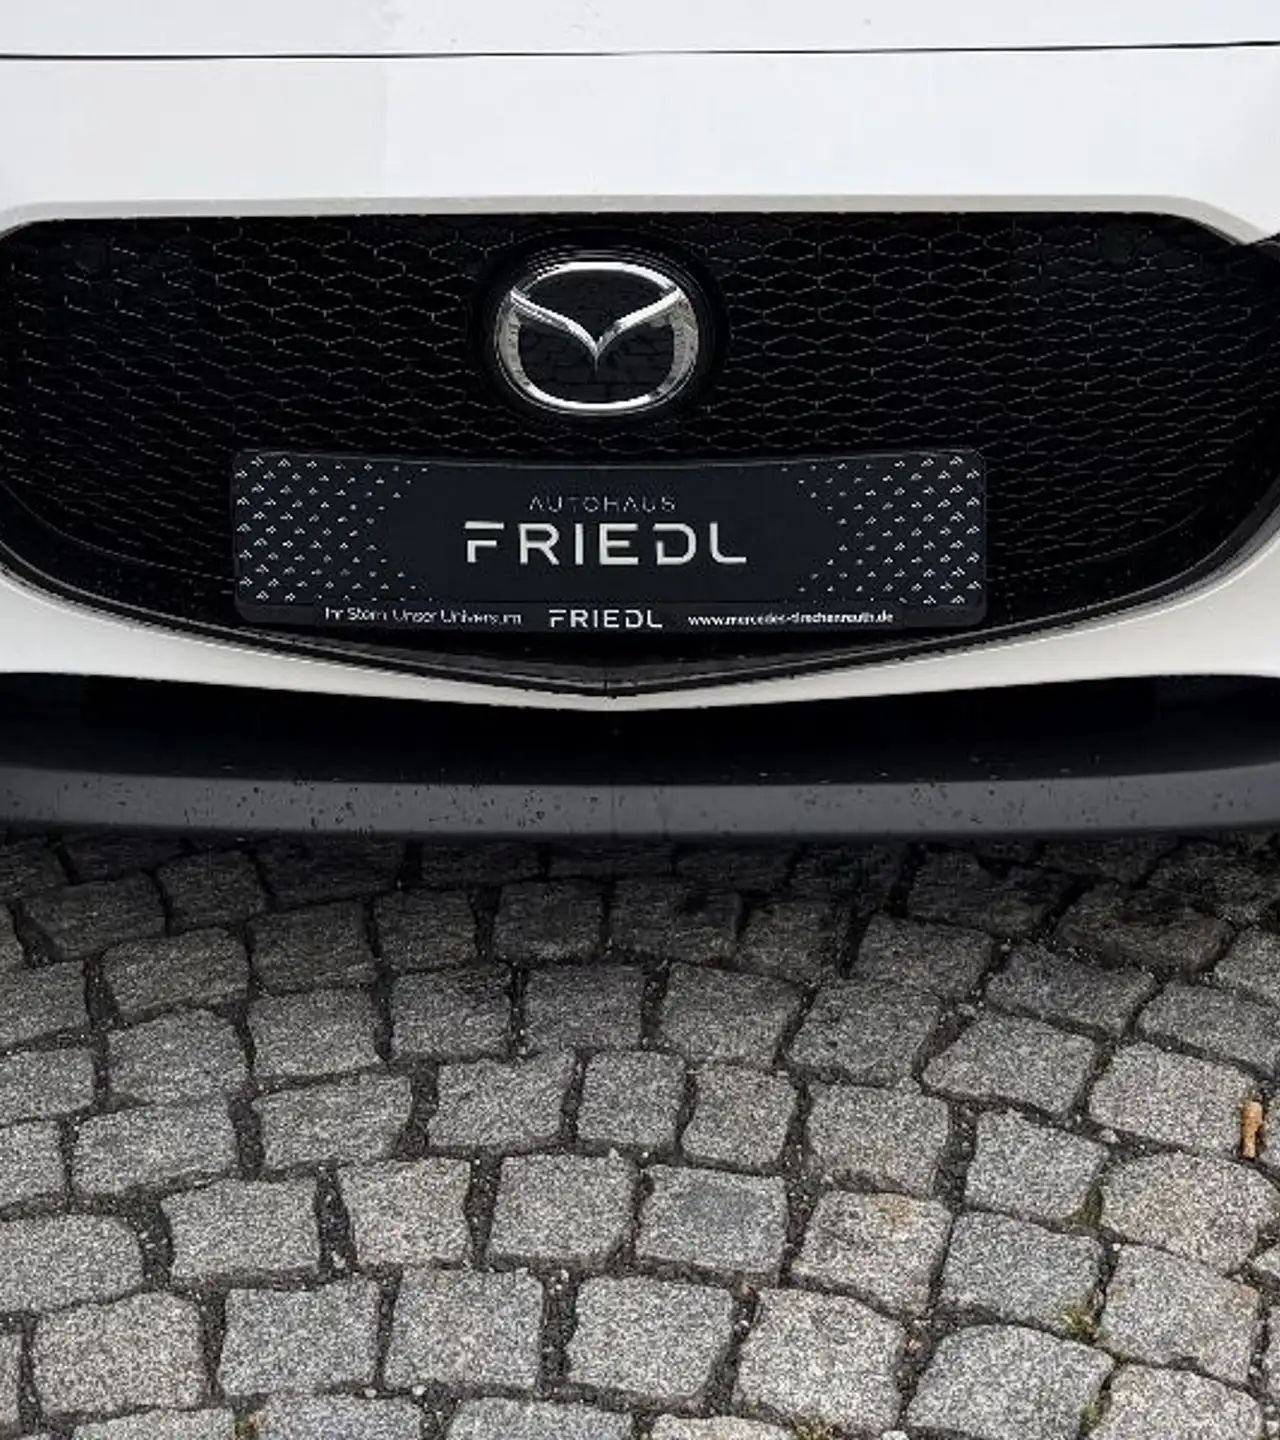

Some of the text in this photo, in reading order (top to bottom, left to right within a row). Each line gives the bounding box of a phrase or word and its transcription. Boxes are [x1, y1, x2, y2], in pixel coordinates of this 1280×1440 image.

[528, 496, 676, 513] AUTOHAUS
[464, 520, 747, 566] FRIEDL
[548, 610, 663, 629] FRIEDL
